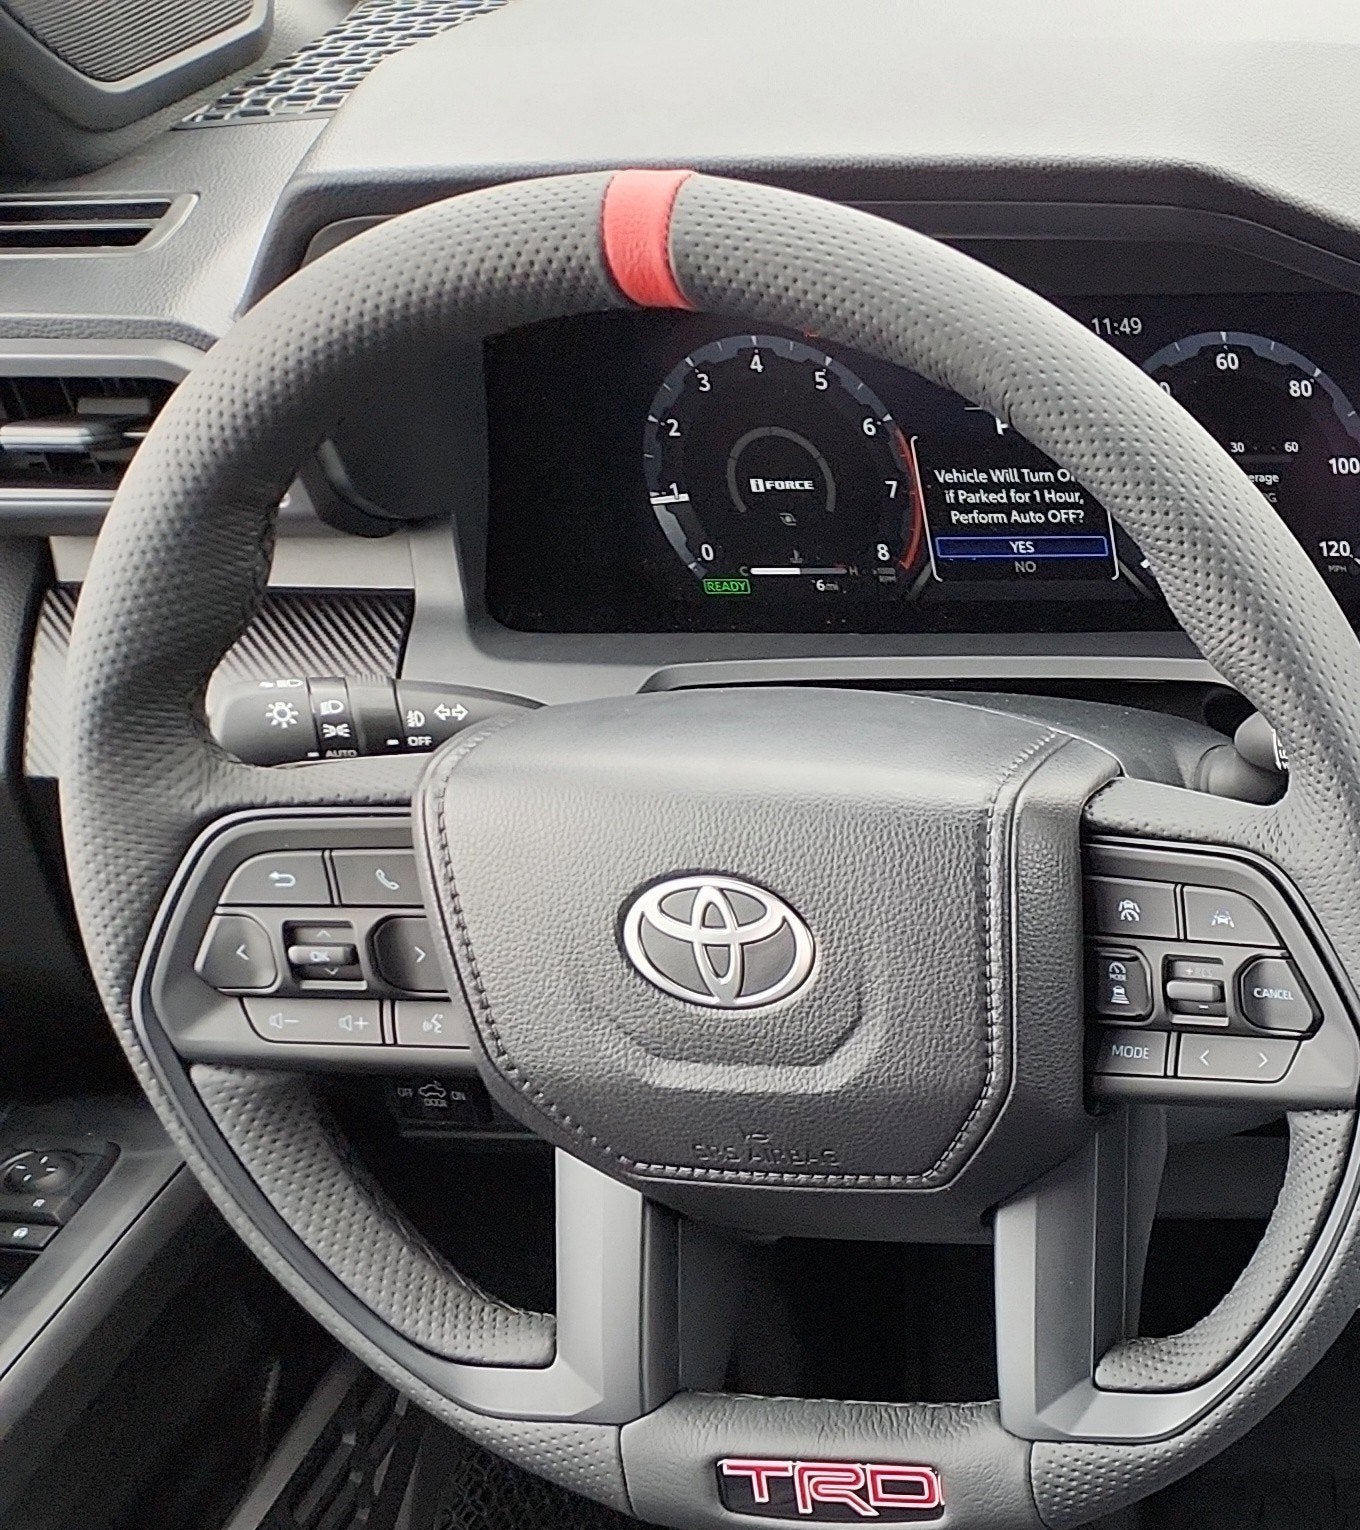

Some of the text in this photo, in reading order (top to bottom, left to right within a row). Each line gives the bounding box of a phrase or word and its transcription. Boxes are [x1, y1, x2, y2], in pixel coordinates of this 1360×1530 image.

[1092, 317, 1142, 334] 11:49
[751, 357, 763, 372] 4
[1216, 354, 1238, 370] 60
[699, 373, 710, 391] 3
[815, 371, 828, 389] 5
[1289, 380, 1312, 397] 80
[667, 420, 681, 436] 2
[863, 418, 876, 435] 6
[1231, 442, 1244, 453] 30
[1285, 441, 1298, 452] 60
[1329, 458, 1360, 474] 100
[934, 469, 1054, 483] Vehicle Will Turn
[1247, 473, 1279, 483] erage
[670, 483, 679, 499] 1
[886, 481, 897, 498] 7
[945, 489, 1084, 504] if Parked for 1 Hour,
[951, 510, 1084, 524] Perform Auto OFF?
[702, 544, 713, 560] 0
[877, 544, 890, 560] 8
[1009, 542, 1035, 553] YES
[1319, 541, 1350, 556] 120
[1015, 561, 1036, 572] NO
[708, 582, 746, 591] READY
[816, 580, 825, 591] 6
[407, 736, 432, 747] OFF
[325, 749, 358, 758] AUTO
[1253, 987, 1294, 1001] CANCEL
[1112, 1045, 1150, 1060] MODE
[717, 1459, 945, 1517] TRD
